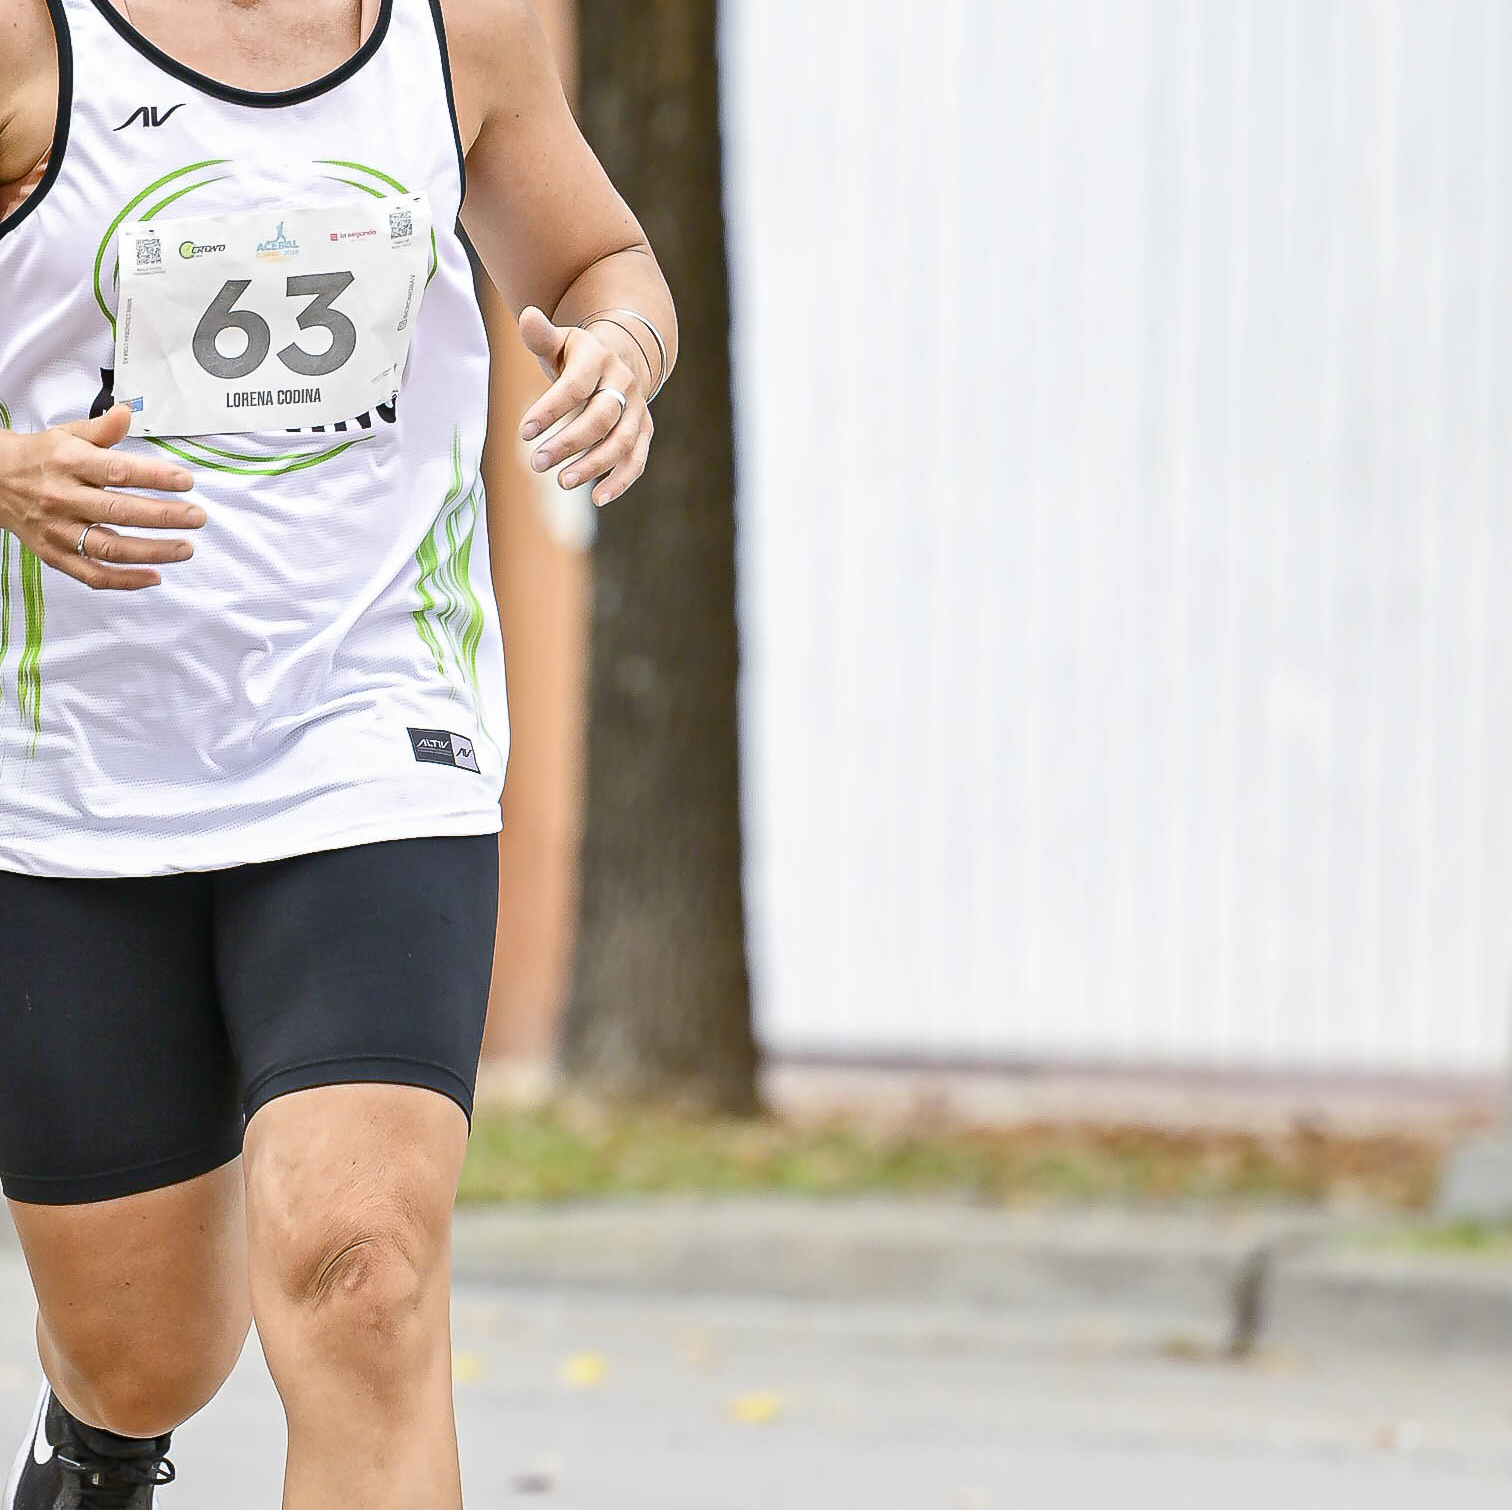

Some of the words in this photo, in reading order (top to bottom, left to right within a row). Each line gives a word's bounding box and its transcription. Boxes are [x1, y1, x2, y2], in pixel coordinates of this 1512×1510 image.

[192, 270, 357, 379] 63
[226, 391, 273, 409] LORENA
[277, 387, 322, 406] CODINA
